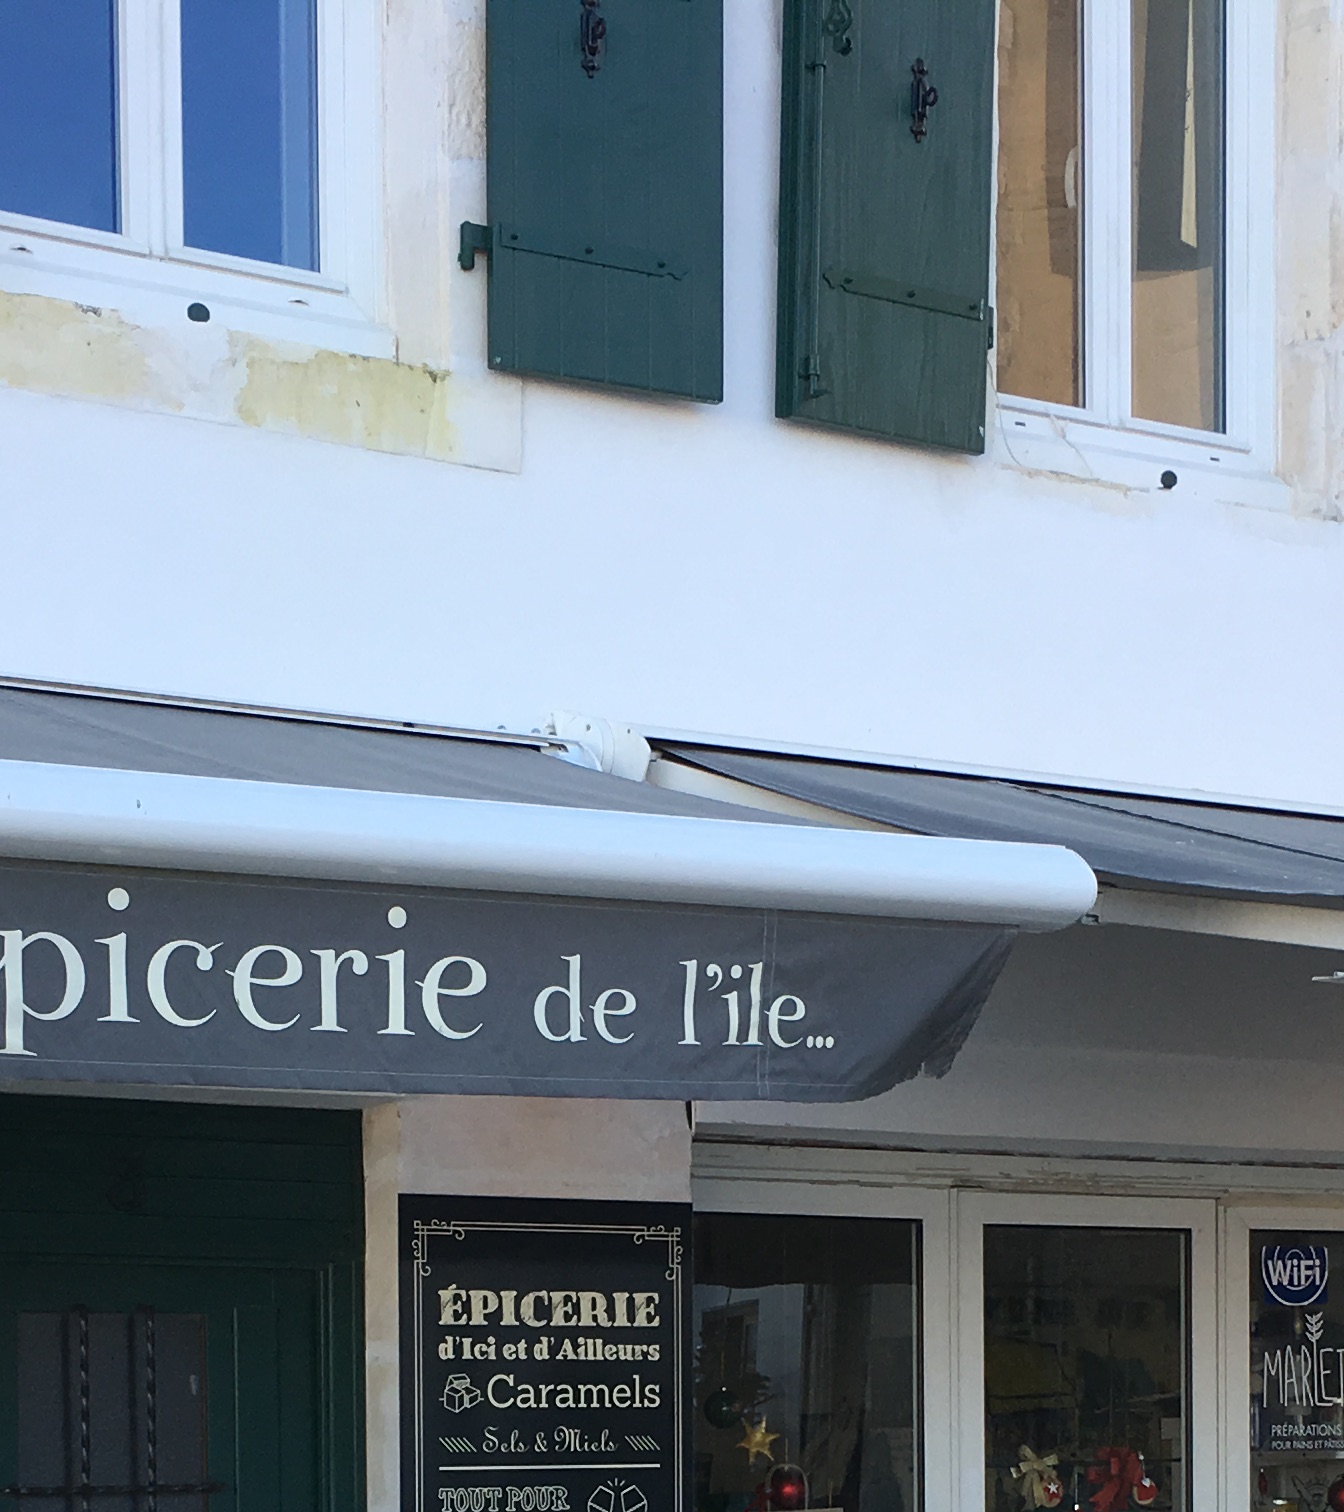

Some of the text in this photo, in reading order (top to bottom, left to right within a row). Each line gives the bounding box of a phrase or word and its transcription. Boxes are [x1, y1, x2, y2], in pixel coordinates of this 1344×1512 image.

[532, 954, 637, 1045] de
[1267, 1258, 1321, 1287] WiFi
[437, 1283, 661, 1328] ÉPICERIE
[438, 1335, 661, 1362] d'Ici et d'Ailleurs
[486, 1373, 661, 1409] Caramels
[482, 1424, 619, 1454] Sels & Miels
[1271, 1422, 1342, 1437] PRÉPARATIONS
[1271, 1440, 1292, 1450] POUR
[505, 1485, 571, 1512] POUR
